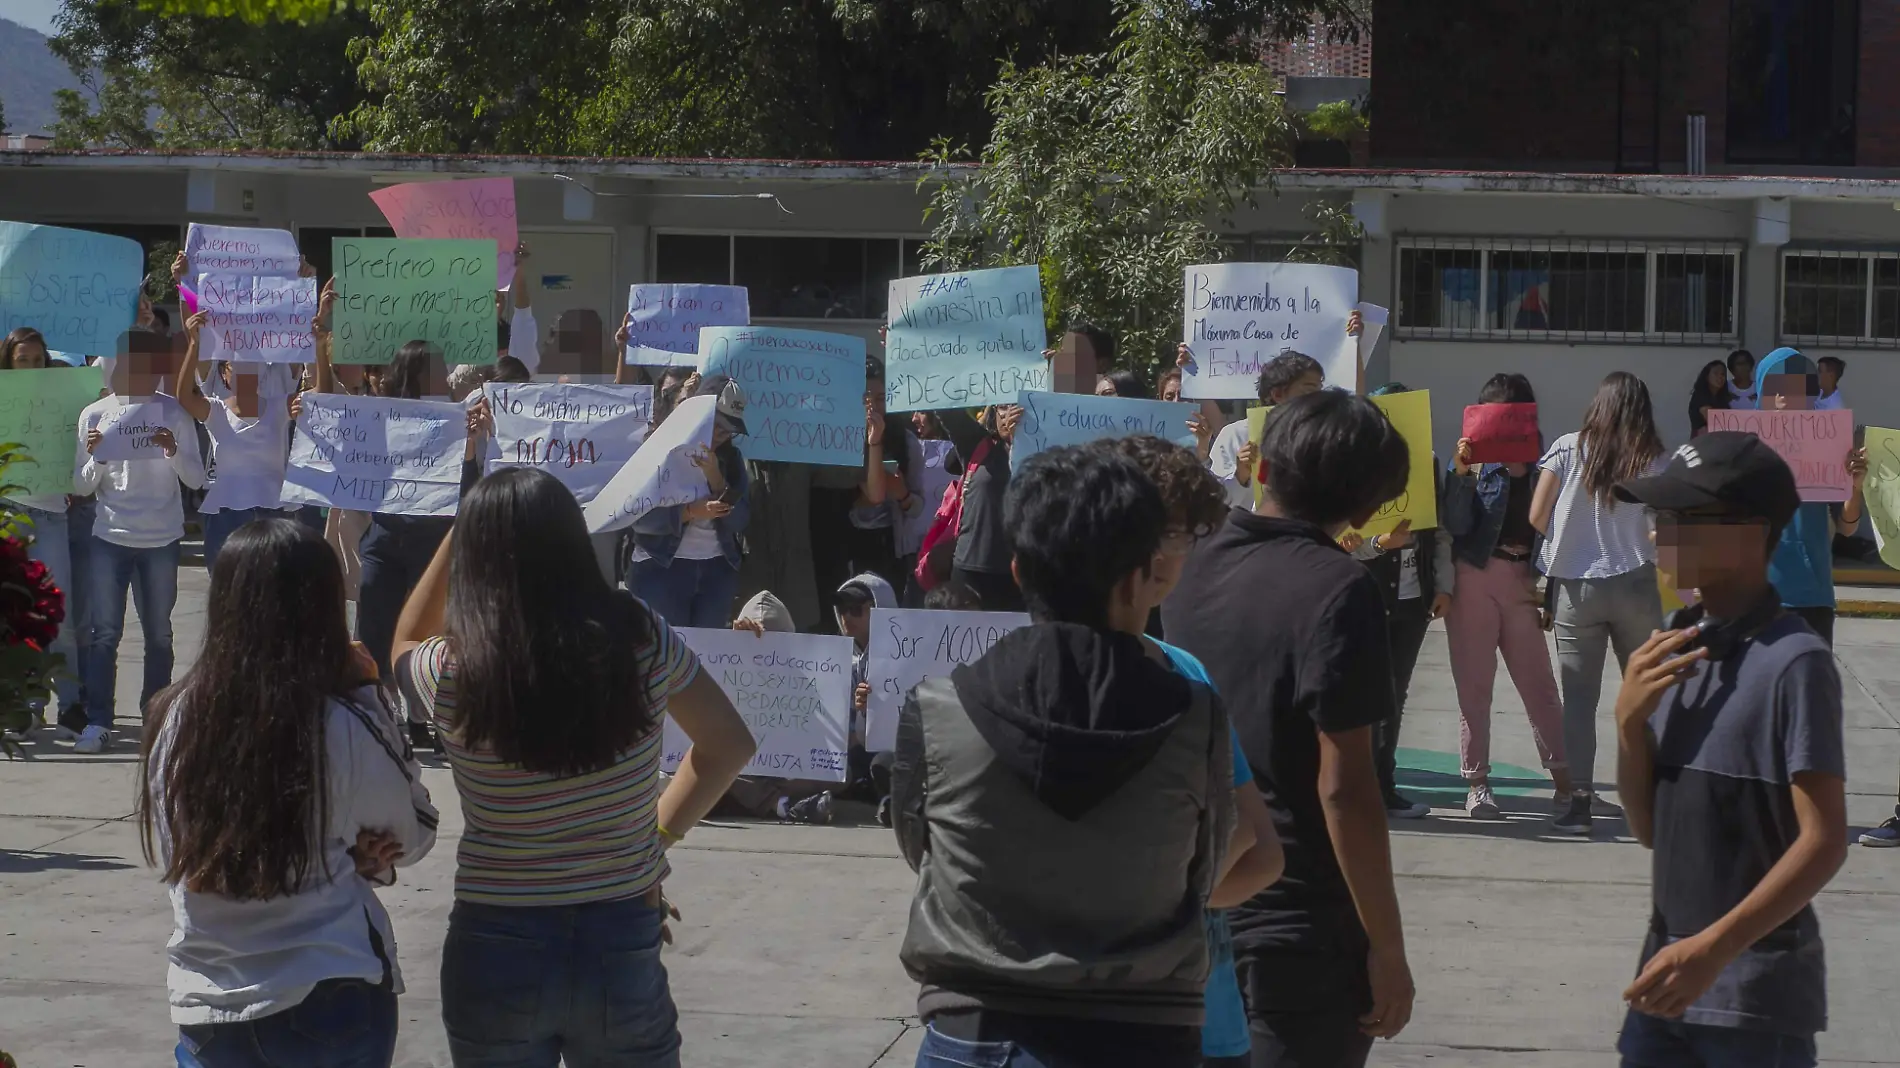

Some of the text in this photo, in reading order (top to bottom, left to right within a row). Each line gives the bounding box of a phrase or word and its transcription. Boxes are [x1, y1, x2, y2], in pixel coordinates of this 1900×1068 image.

[263, 257, 284, 272] no
[342, 244, 435, 280] Prefiero
[448, 256, 482, 276] no
[204, 278, 314, 308] Queremos
[338, 284, 497, 321] tener maestros
[1192, 272, 1321, 316] Bienvenidos a la
[289, 311, 307, 326] no
[340, 319, 358, 341] a
[363, 320, 411, 341] venir
[417, 318, 429, 341] a
[223, 328, 312, 351] ABUSADORES
[1280, 323, 1300, 341] de
[890, 328, 1036, 362] doctorado quita lo
[310, 400, 401, 422] Asistir a la
[492, 388, 524, 416] No
[587, 404, 626, 424] pero
[745, 390, 837, 415] CADORES
[311, 424, 367, 443] escuela
[1058, 405, 1116, 432] educas
[1123, 414, 1143, 432] en
[1149, 414, 1166, 439] la
[412, 452, 439, 472] dar
[516, 437, 604, 469] acosa
[332, 474, 417, 502] MIEDO
[888, 616, 923, 660] Ser
[707, 650, 842, 675] una educación
[883, 676, 900, 695] es
